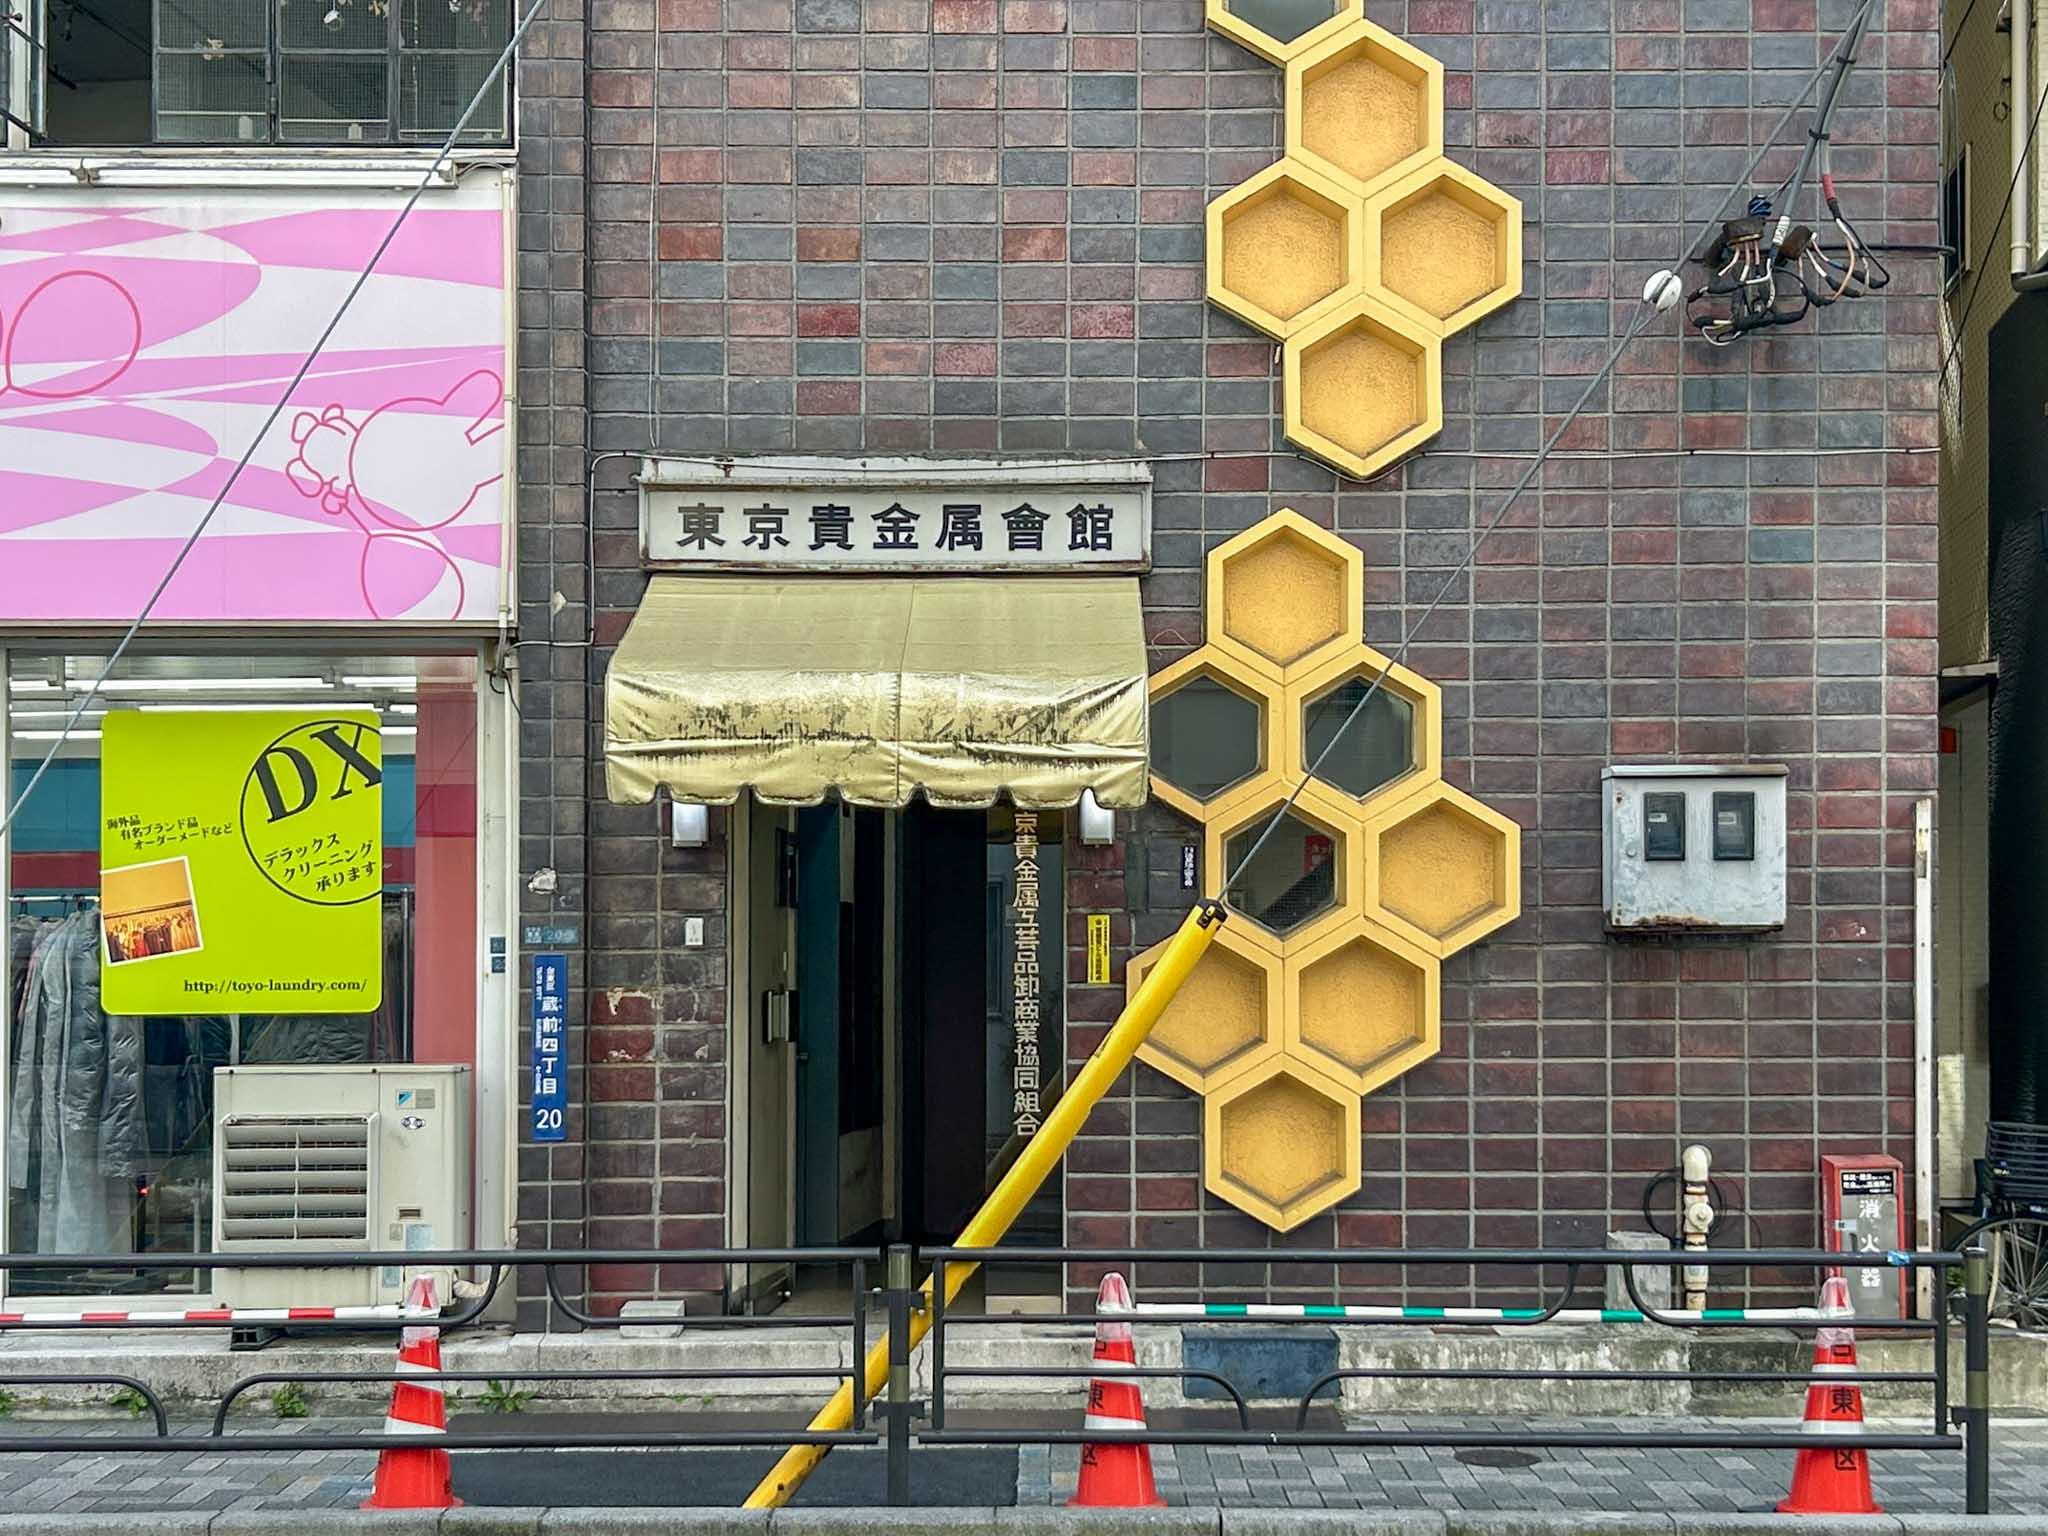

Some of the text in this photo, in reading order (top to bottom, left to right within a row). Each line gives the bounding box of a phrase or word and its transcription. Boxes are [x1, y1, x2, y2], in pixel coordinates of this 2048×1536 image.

[677, 502, 1114, 551] 東京貴金属會館
[255, 724, 382, 823] DX
[264, 832, 341, 869] デラックス
[284, 839, 374, 883] クリーニング
[316, 860, 377, 892] 承ります
[184, 979, 368, 994] http://toyo-laundry.com/
[541, 995, 559, 1094] 蔵前四丁目
[535, 1108, 563, 1129] 20
[1858, 1198, 1881, 1288] 消火器
